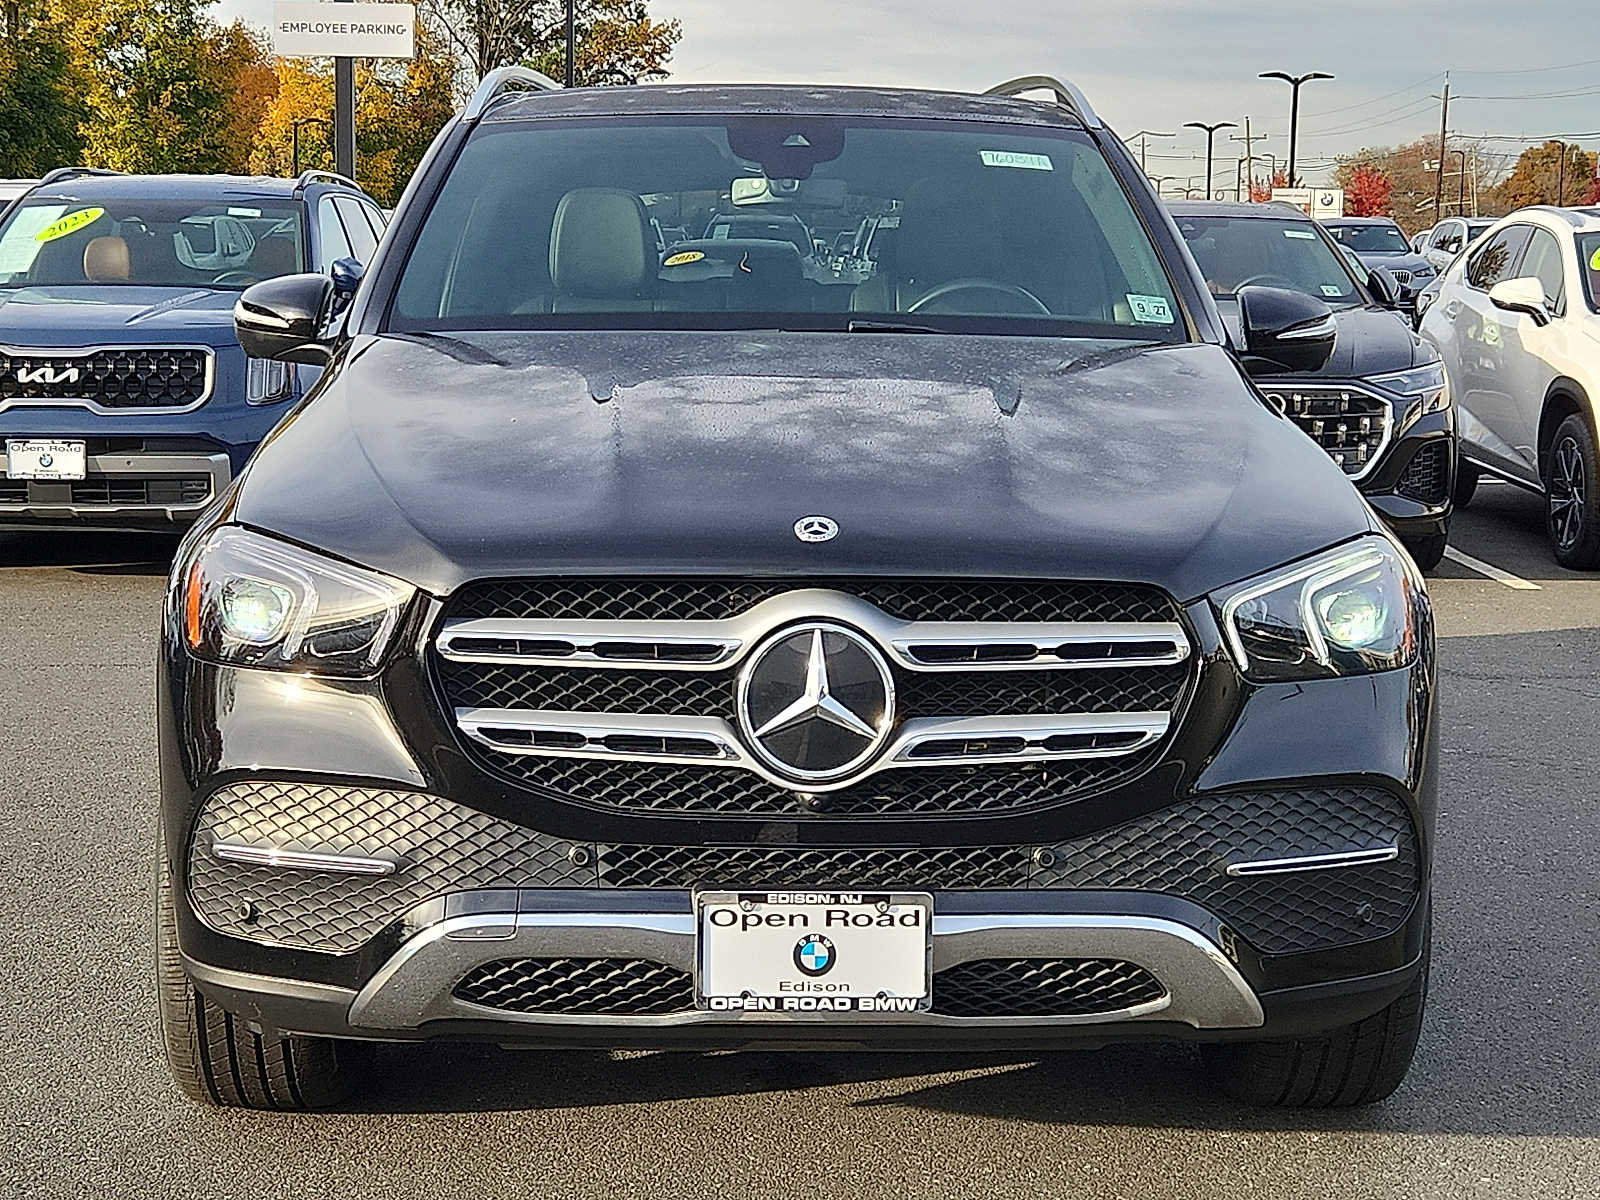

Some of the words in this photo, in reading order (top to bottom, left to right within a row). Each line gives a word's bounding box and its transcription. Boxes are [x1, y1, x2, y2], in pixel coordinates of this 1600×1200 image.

[282, 22, 347, 34] EMPLOYEE
[350, 23, 405, 35] PARKING
[48, 211, 91, 238] 2023
[1137, 302, 1146, 313] 9
[1153, 305, 1166, 316] 27
[11, 444, 44, 452] Open
[767, 894, 835, 904] EDISON,
[840, 894, 862, 904] NJ
[709, 909, 809, 931] Open
[825, 909, 920, 928] Road
[779, 981, 850, 992] Edison
[710, 998, 776, 1011] OPEN
[783, 998, 851, 1011] ROAD
[858, 998, 918, 1011] BMW
